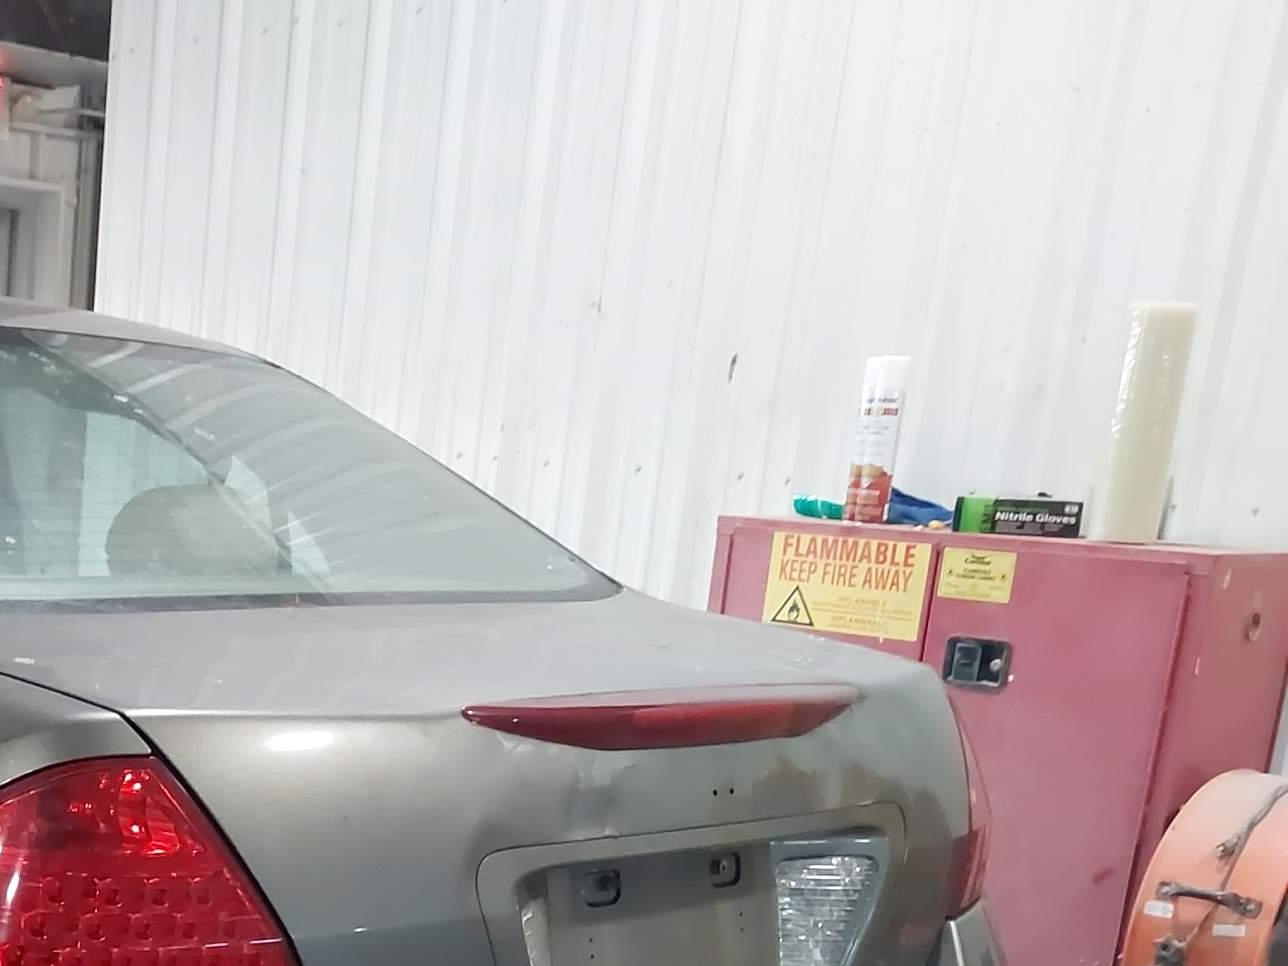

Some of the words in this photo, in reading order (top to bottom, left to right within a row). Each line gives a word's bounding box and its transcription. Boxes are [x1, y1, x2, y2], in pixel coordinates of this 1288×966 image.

[994, 511, 1034, 523] Nitrile
[1035, 513, 1077, 525] Gloves
[781, 534, 918, 568] FLAMMABLE
[778, 559, 818, 583] KEEP
[821, 562, 859, 588] FIRE
[862, 566, 914, 593] AWAY
